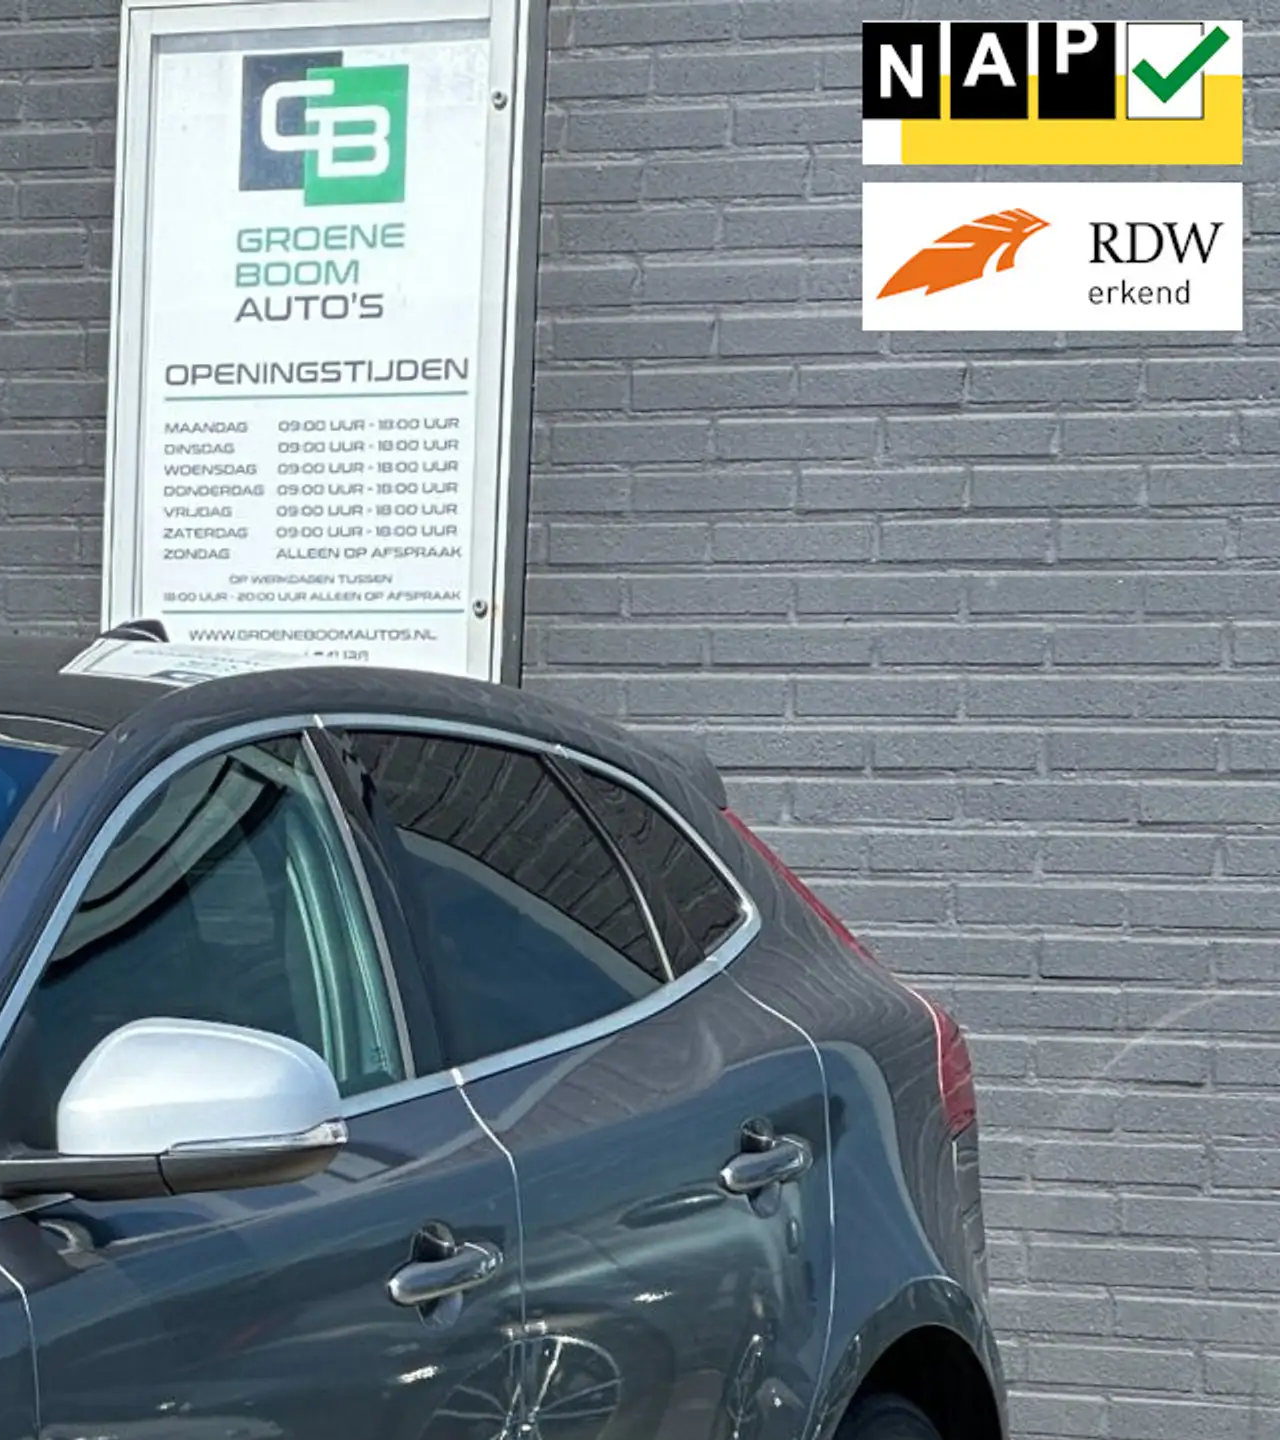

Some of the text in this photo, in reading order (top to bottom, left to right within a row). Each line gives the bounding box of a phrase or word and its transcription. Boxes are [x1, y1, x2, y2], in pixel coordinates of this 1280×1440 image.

[237, 222, 405, 253] GROENE
[235, 259, 359, 288] BOOM
[235, 292, 383, 322] AUTO'S
[166, 358, 468, 385] OPENINGSTIJDEN
[165, 422, 248, 433] MAANDAG
[330, 419, 365, 431] UUR
[424, 418, 459, 429] UUR
[164, 443, 235, 455] DINSDAG
[329, 441, 365, 452] UUR
[423, 439, 459, 451] UUR
[164, 464, 257, 476] WOENSDAG
[329, 462, 364, 474] UUR
[423, 460, 458, 472] UUR
[164, 484, 264, 497] DONDERDAG
[328, 483, 364, 495] UUR
[422, 482, 458, 494] UUR
[164, 506, 232, 518] VRIJDAG
[328, 505, 363, 516] UUR
[422, 503, 457, 515] UUR
[163, 527, 248, 539] ZATERDAG
[327, 526, 363, 537] UUR
[421, 525, 457, 537] UUR
[164, 547, 461, 560] ZONDAG ALLEEN OP AFSPRAAK
